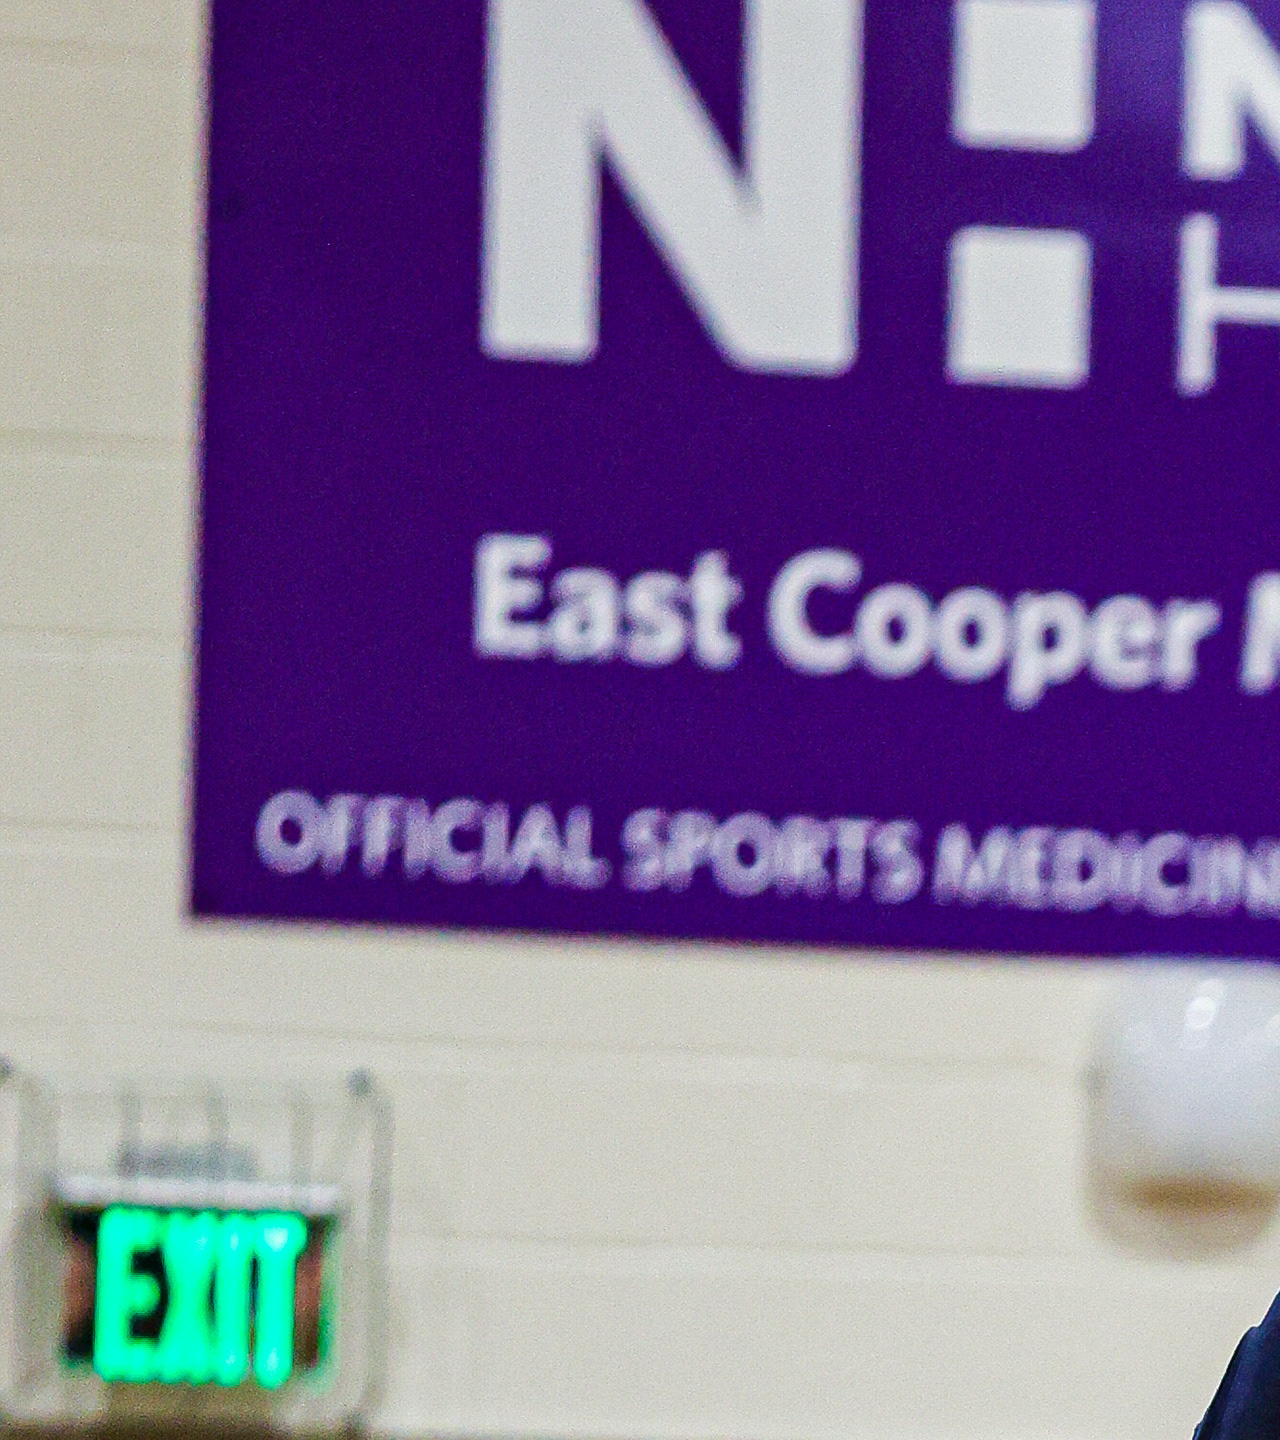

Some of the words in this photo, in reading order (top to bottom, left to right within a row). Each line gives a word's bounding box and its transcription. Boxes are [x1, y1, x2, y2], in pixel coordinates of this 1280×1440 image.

[473, 536, 737, 665] East
[770, 551, 1218, 705] Cooper
[258, 793, 602, 883] OFFICIAL
[625, 810, 922, 901] SPORTS
[95, 1208, 306, 1387] EXIT
